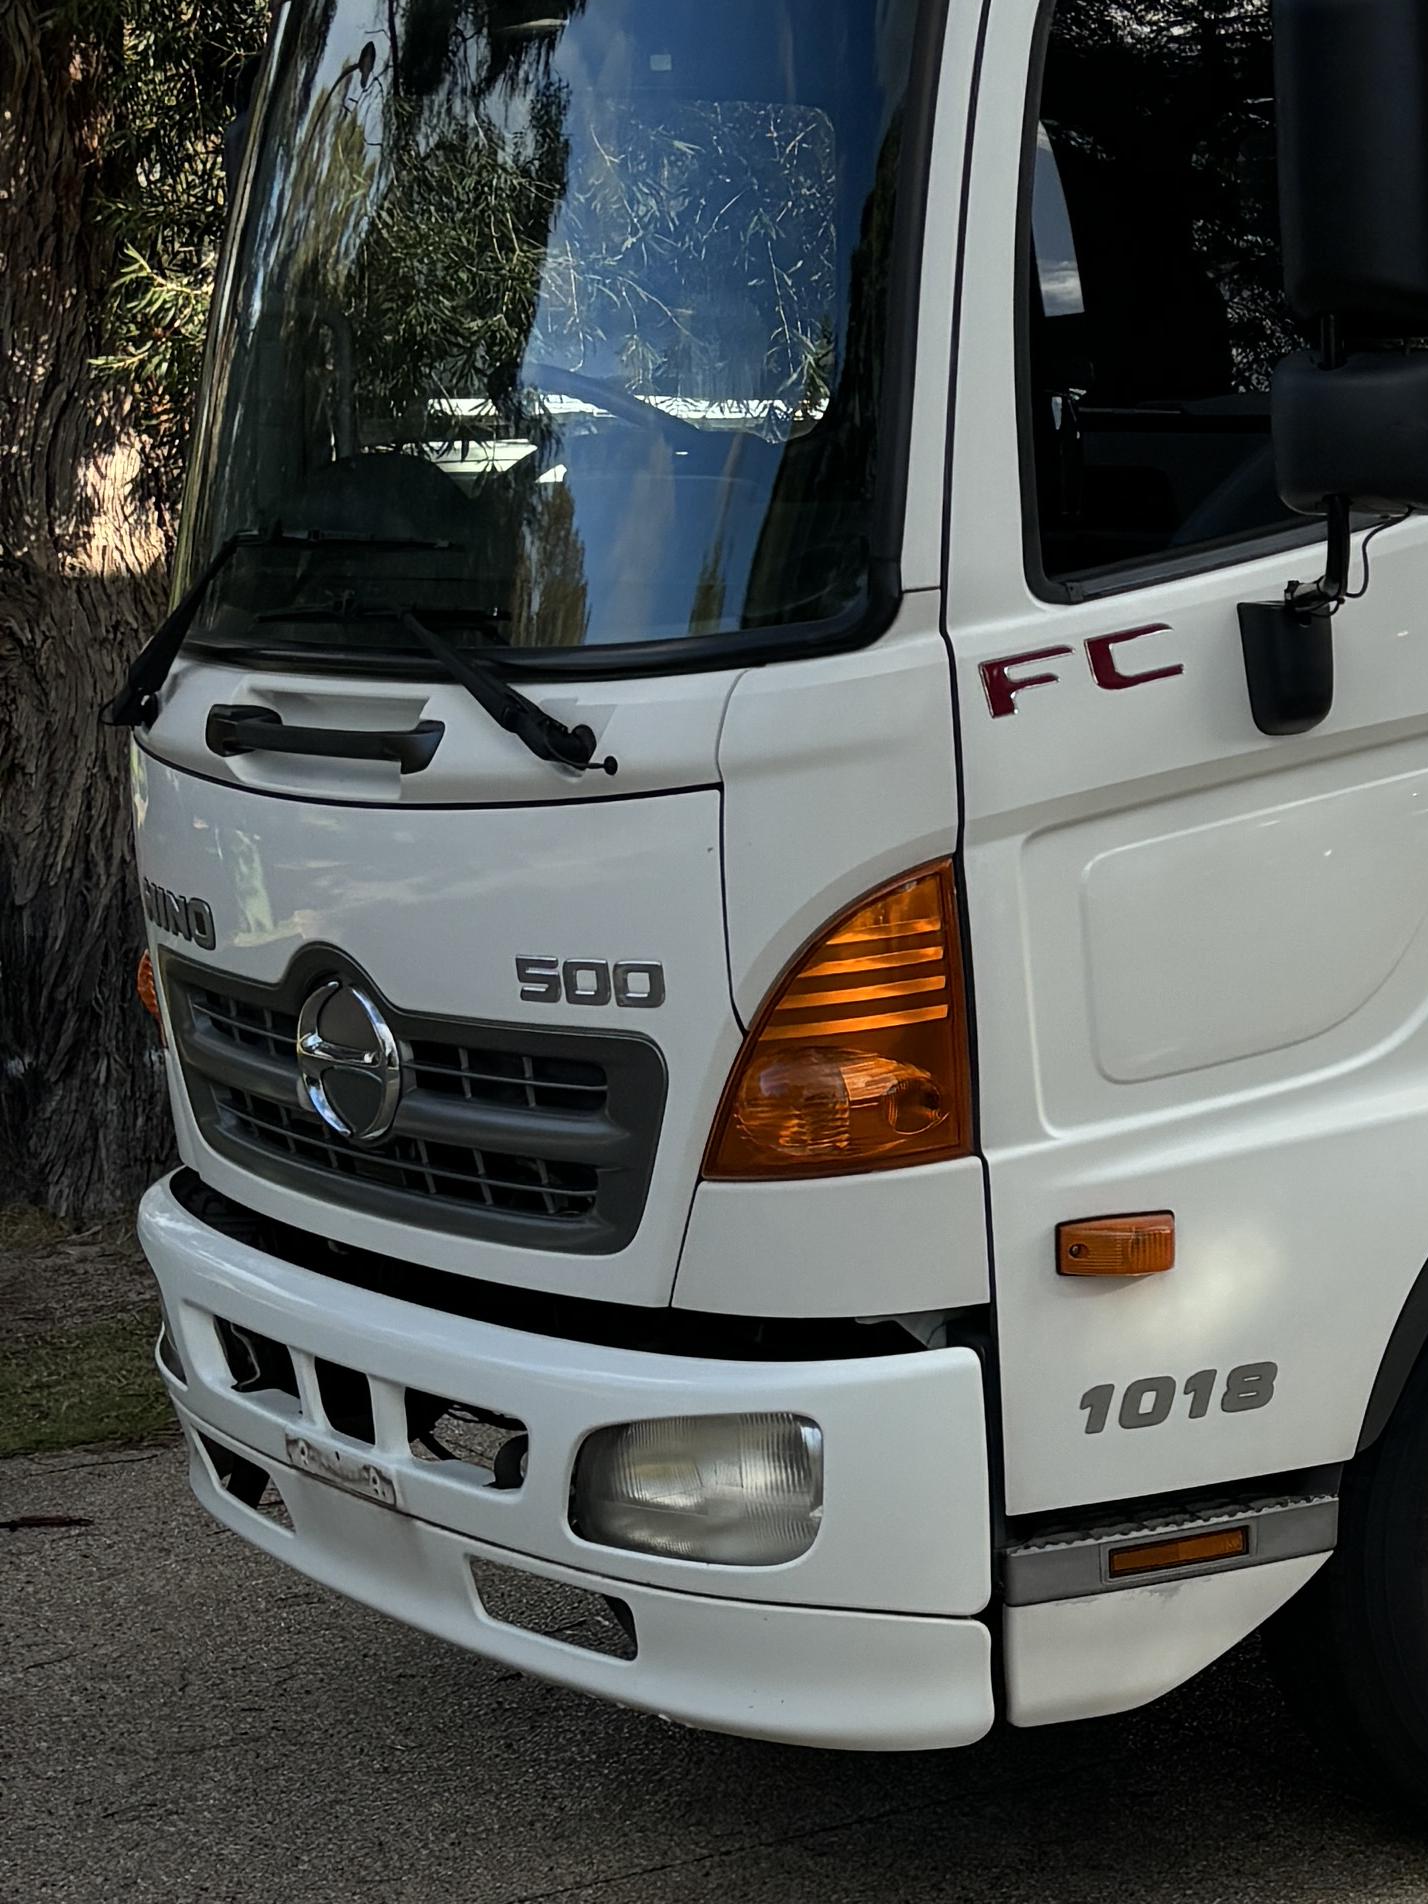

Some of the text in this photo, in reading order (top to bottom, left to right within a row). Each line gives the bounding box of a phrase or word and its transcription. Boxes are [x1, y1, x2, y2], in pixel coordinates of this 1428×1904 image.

[978, 622, 1183, 718] FC
[515, 954, 665, 1008] 500
[1079, 1361, 1277, 1434] 1018
